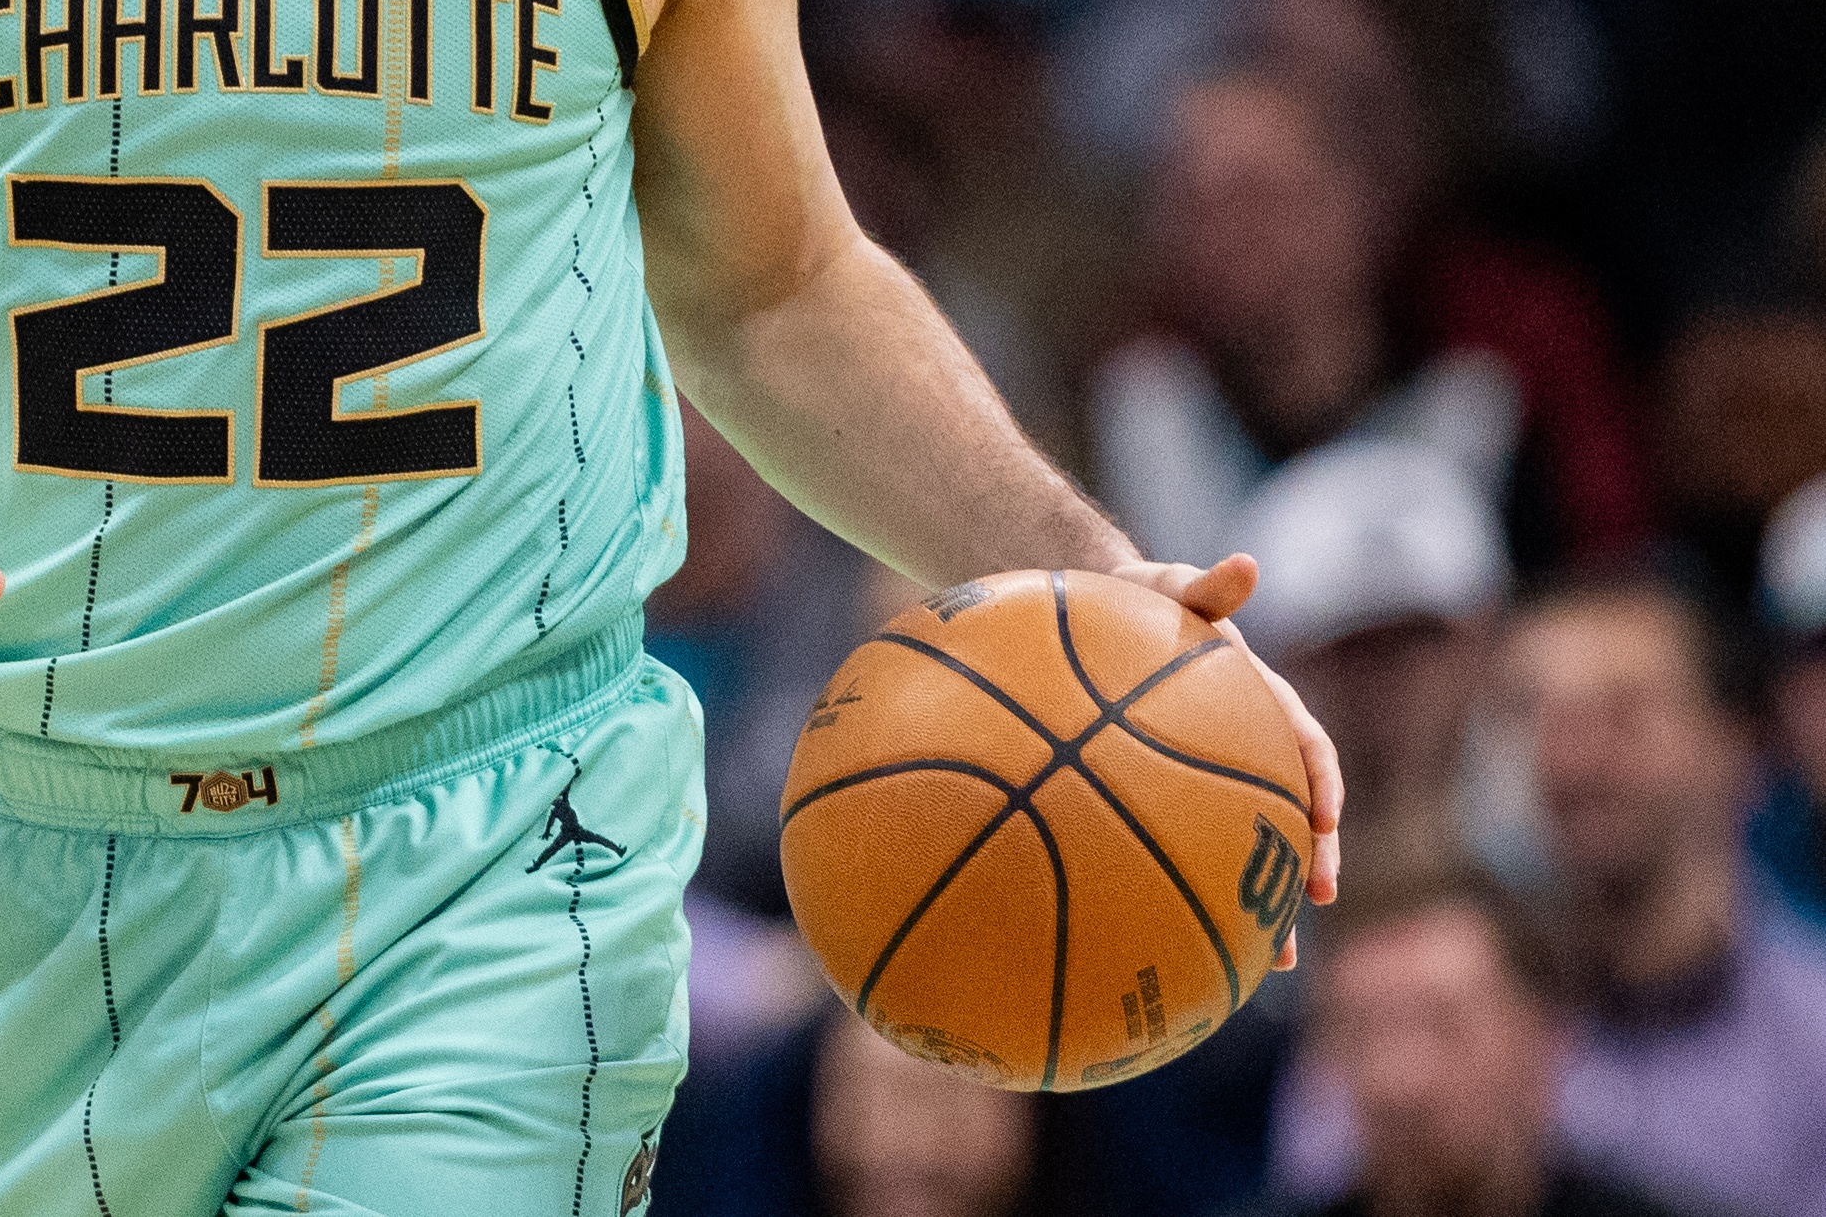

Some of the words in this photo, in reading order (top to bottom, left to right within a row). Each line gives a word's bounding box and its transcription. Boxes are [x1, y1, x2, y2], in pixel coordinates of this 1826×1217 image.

[6, 174, 489, 488] 22
[209, 782, 238, 796] BUZZ
[212, 794, 238, 806] CITY
